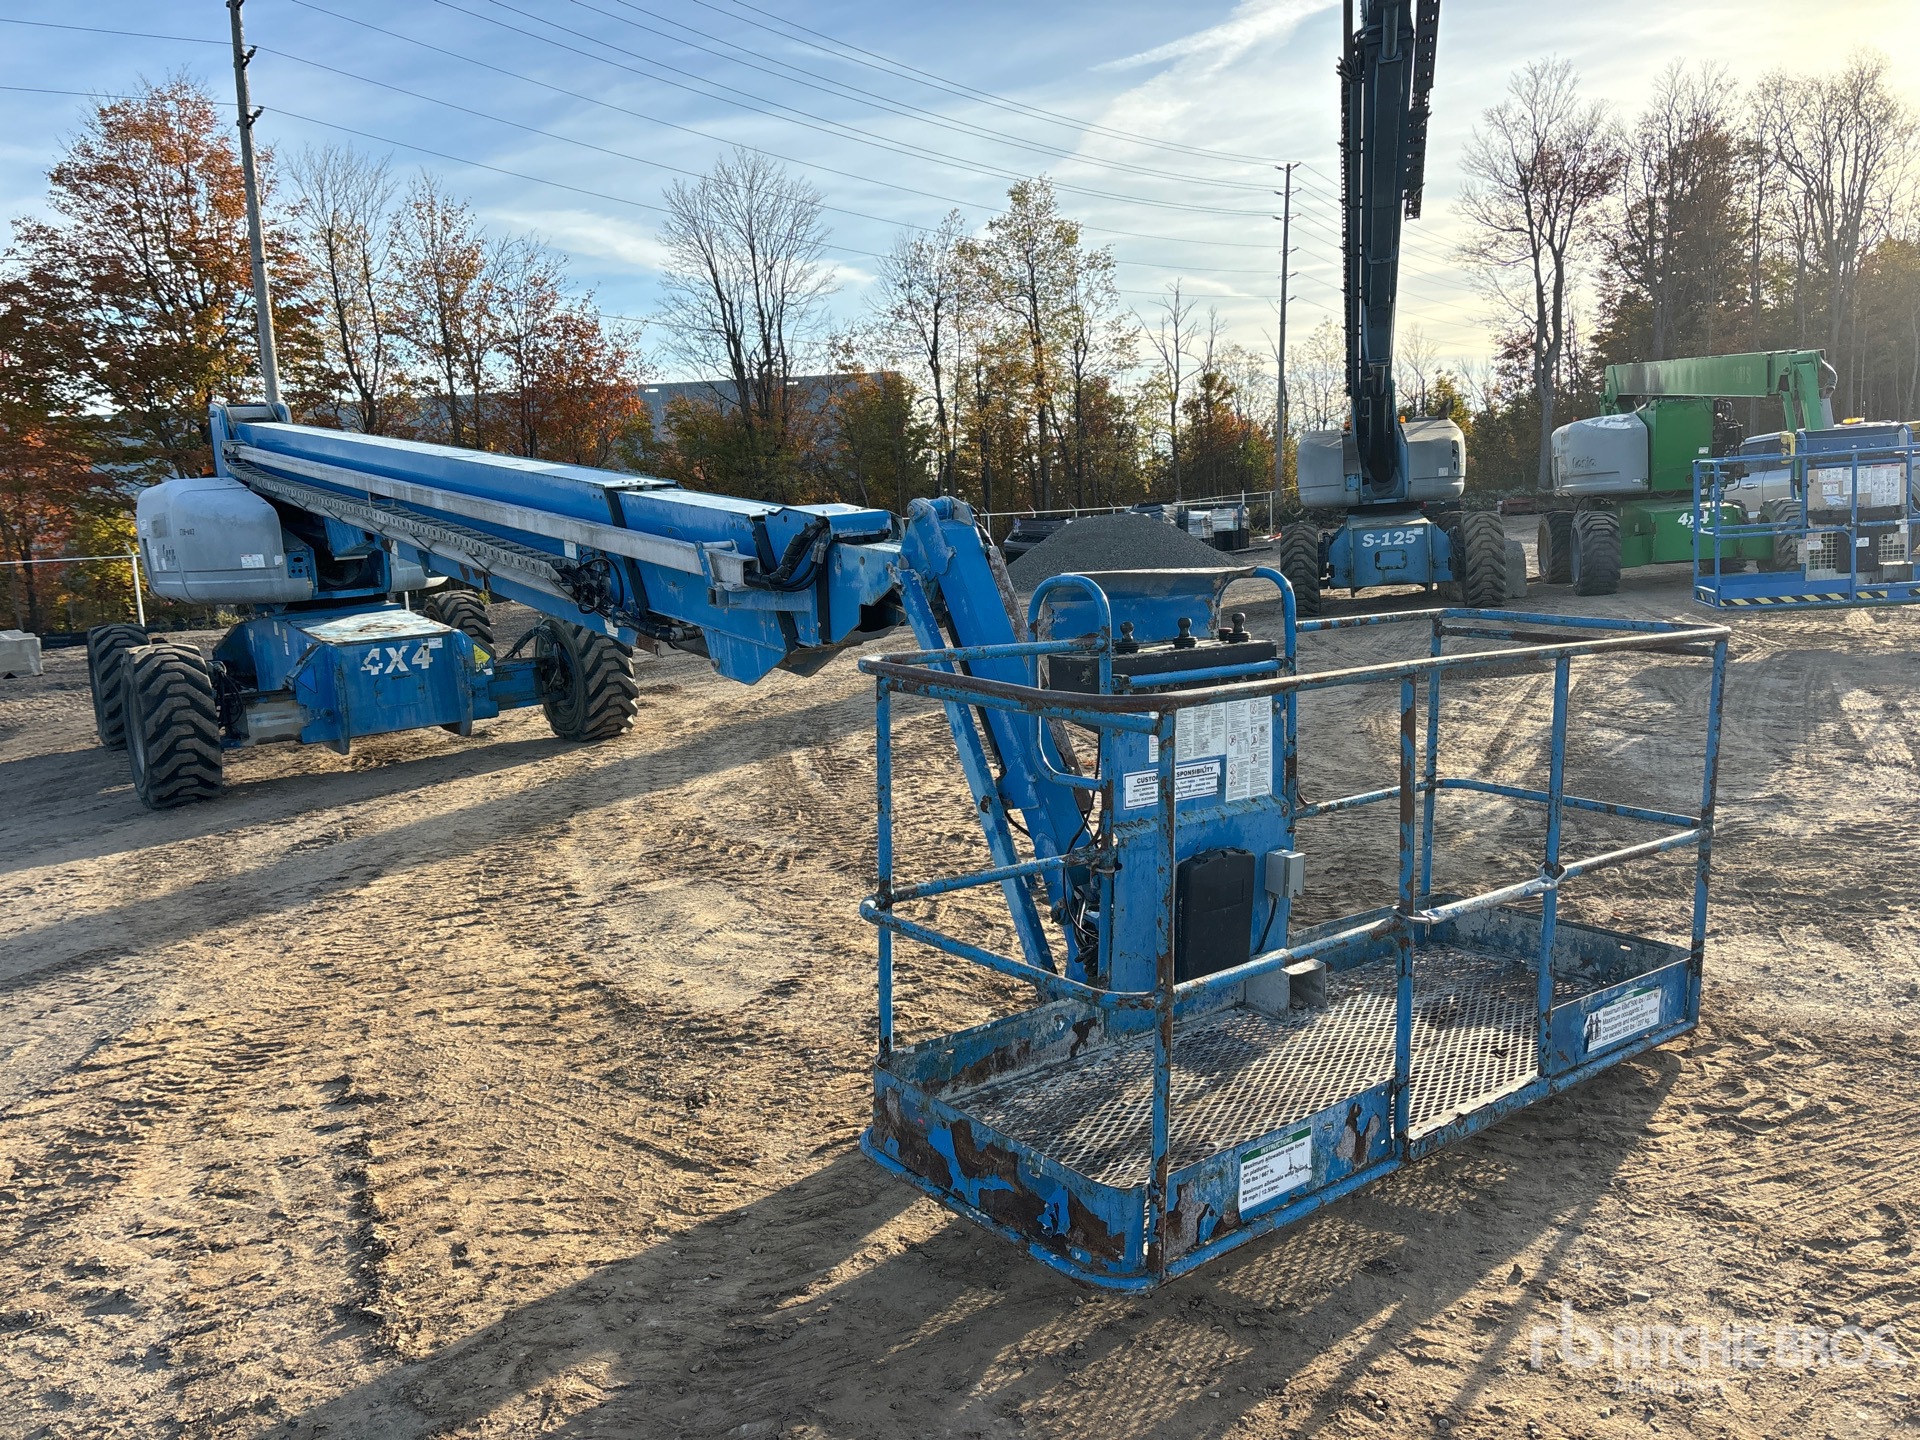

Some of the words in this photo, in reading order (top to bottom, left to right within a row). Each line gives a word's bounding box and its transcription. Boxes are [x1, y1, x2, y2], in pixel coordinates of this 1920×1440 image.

[1362, 530, 1416, 548] S-125
[1176, 766, 1214, 777] SPONSIBILITY
[1602, 1014, 1621, 1025] Maximum
[1260, 1136, 1294, 1154] INSTRUCTIONS
[1243, 1158, 1265, 1171] Maximum
[1264, 1150, 1285, 1162] allowable
[1294, 1141, 1306, 1150] force
[1242, 1184, 1264, 1196] Maximum
[1263, 1175, 1284, 1187] allowable
[1248, 1193, 1259, 1201] mph
